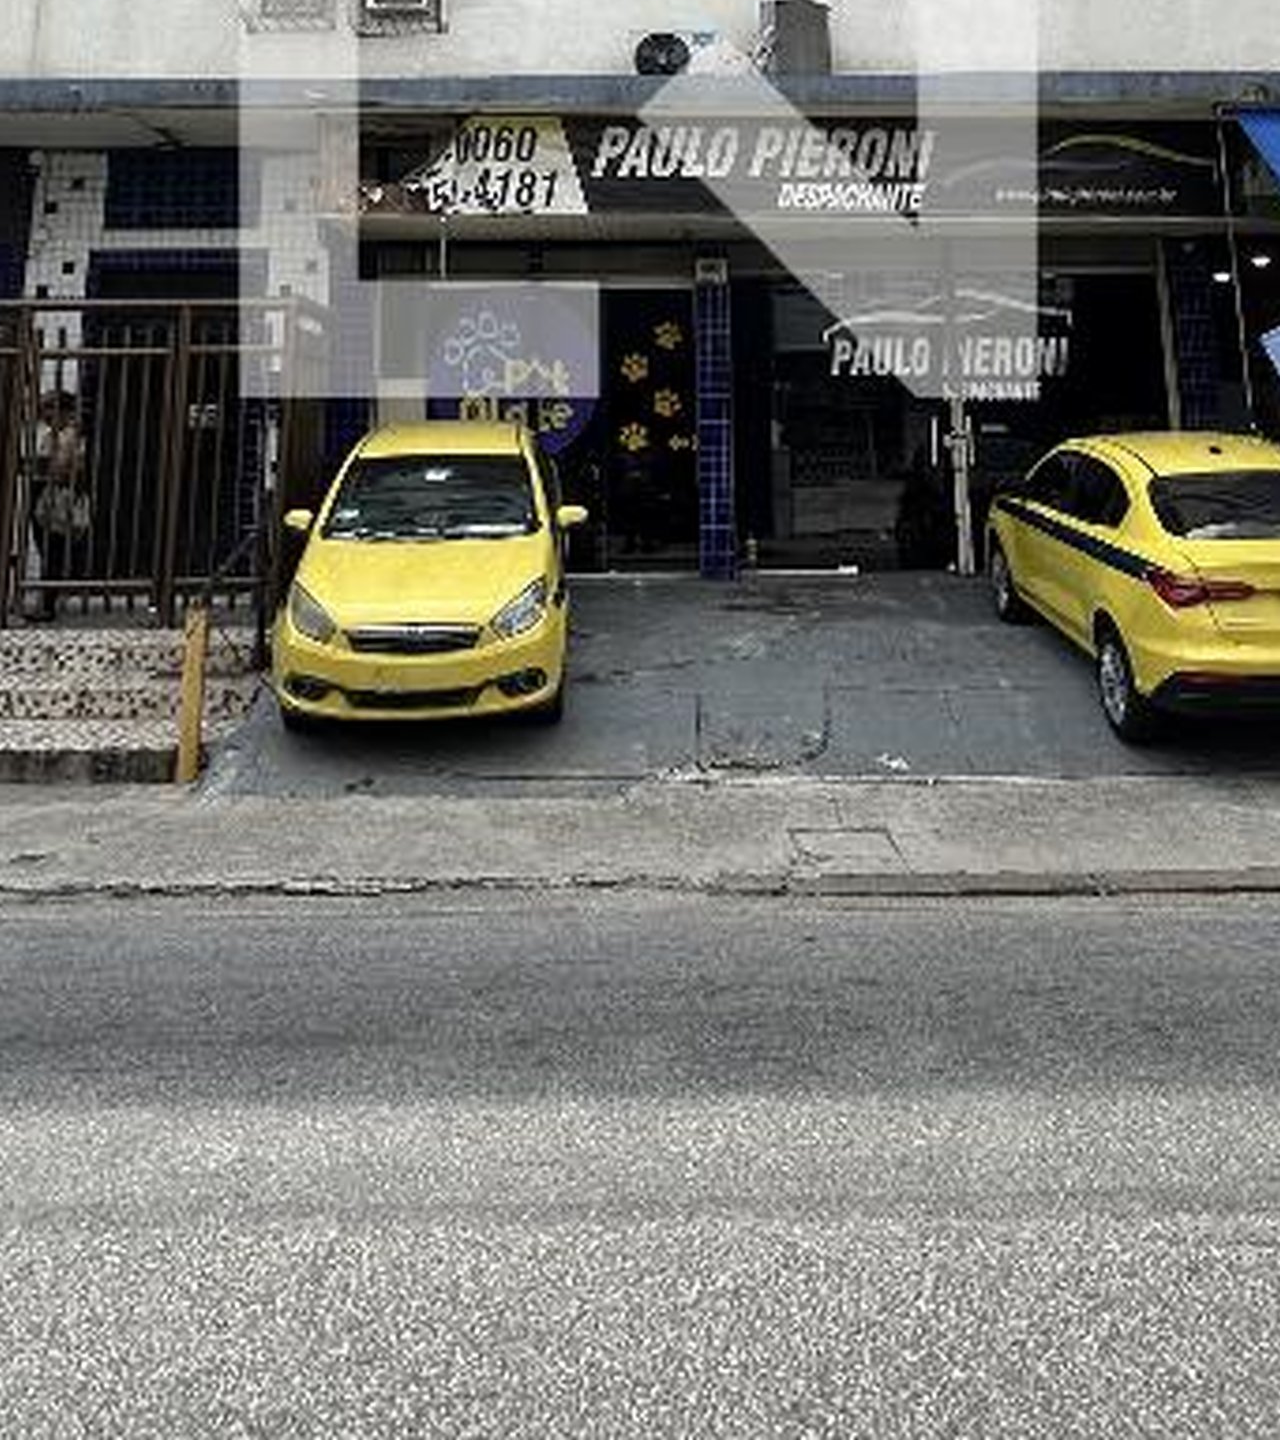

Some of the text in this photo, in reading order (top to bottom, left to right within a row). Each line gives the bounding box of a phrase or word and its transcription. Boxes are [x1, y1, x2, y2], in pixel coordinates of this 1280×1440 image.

[590, 127, 938, 178] PAULO PIERONI
[830, 337, 930, 376] PAULO
